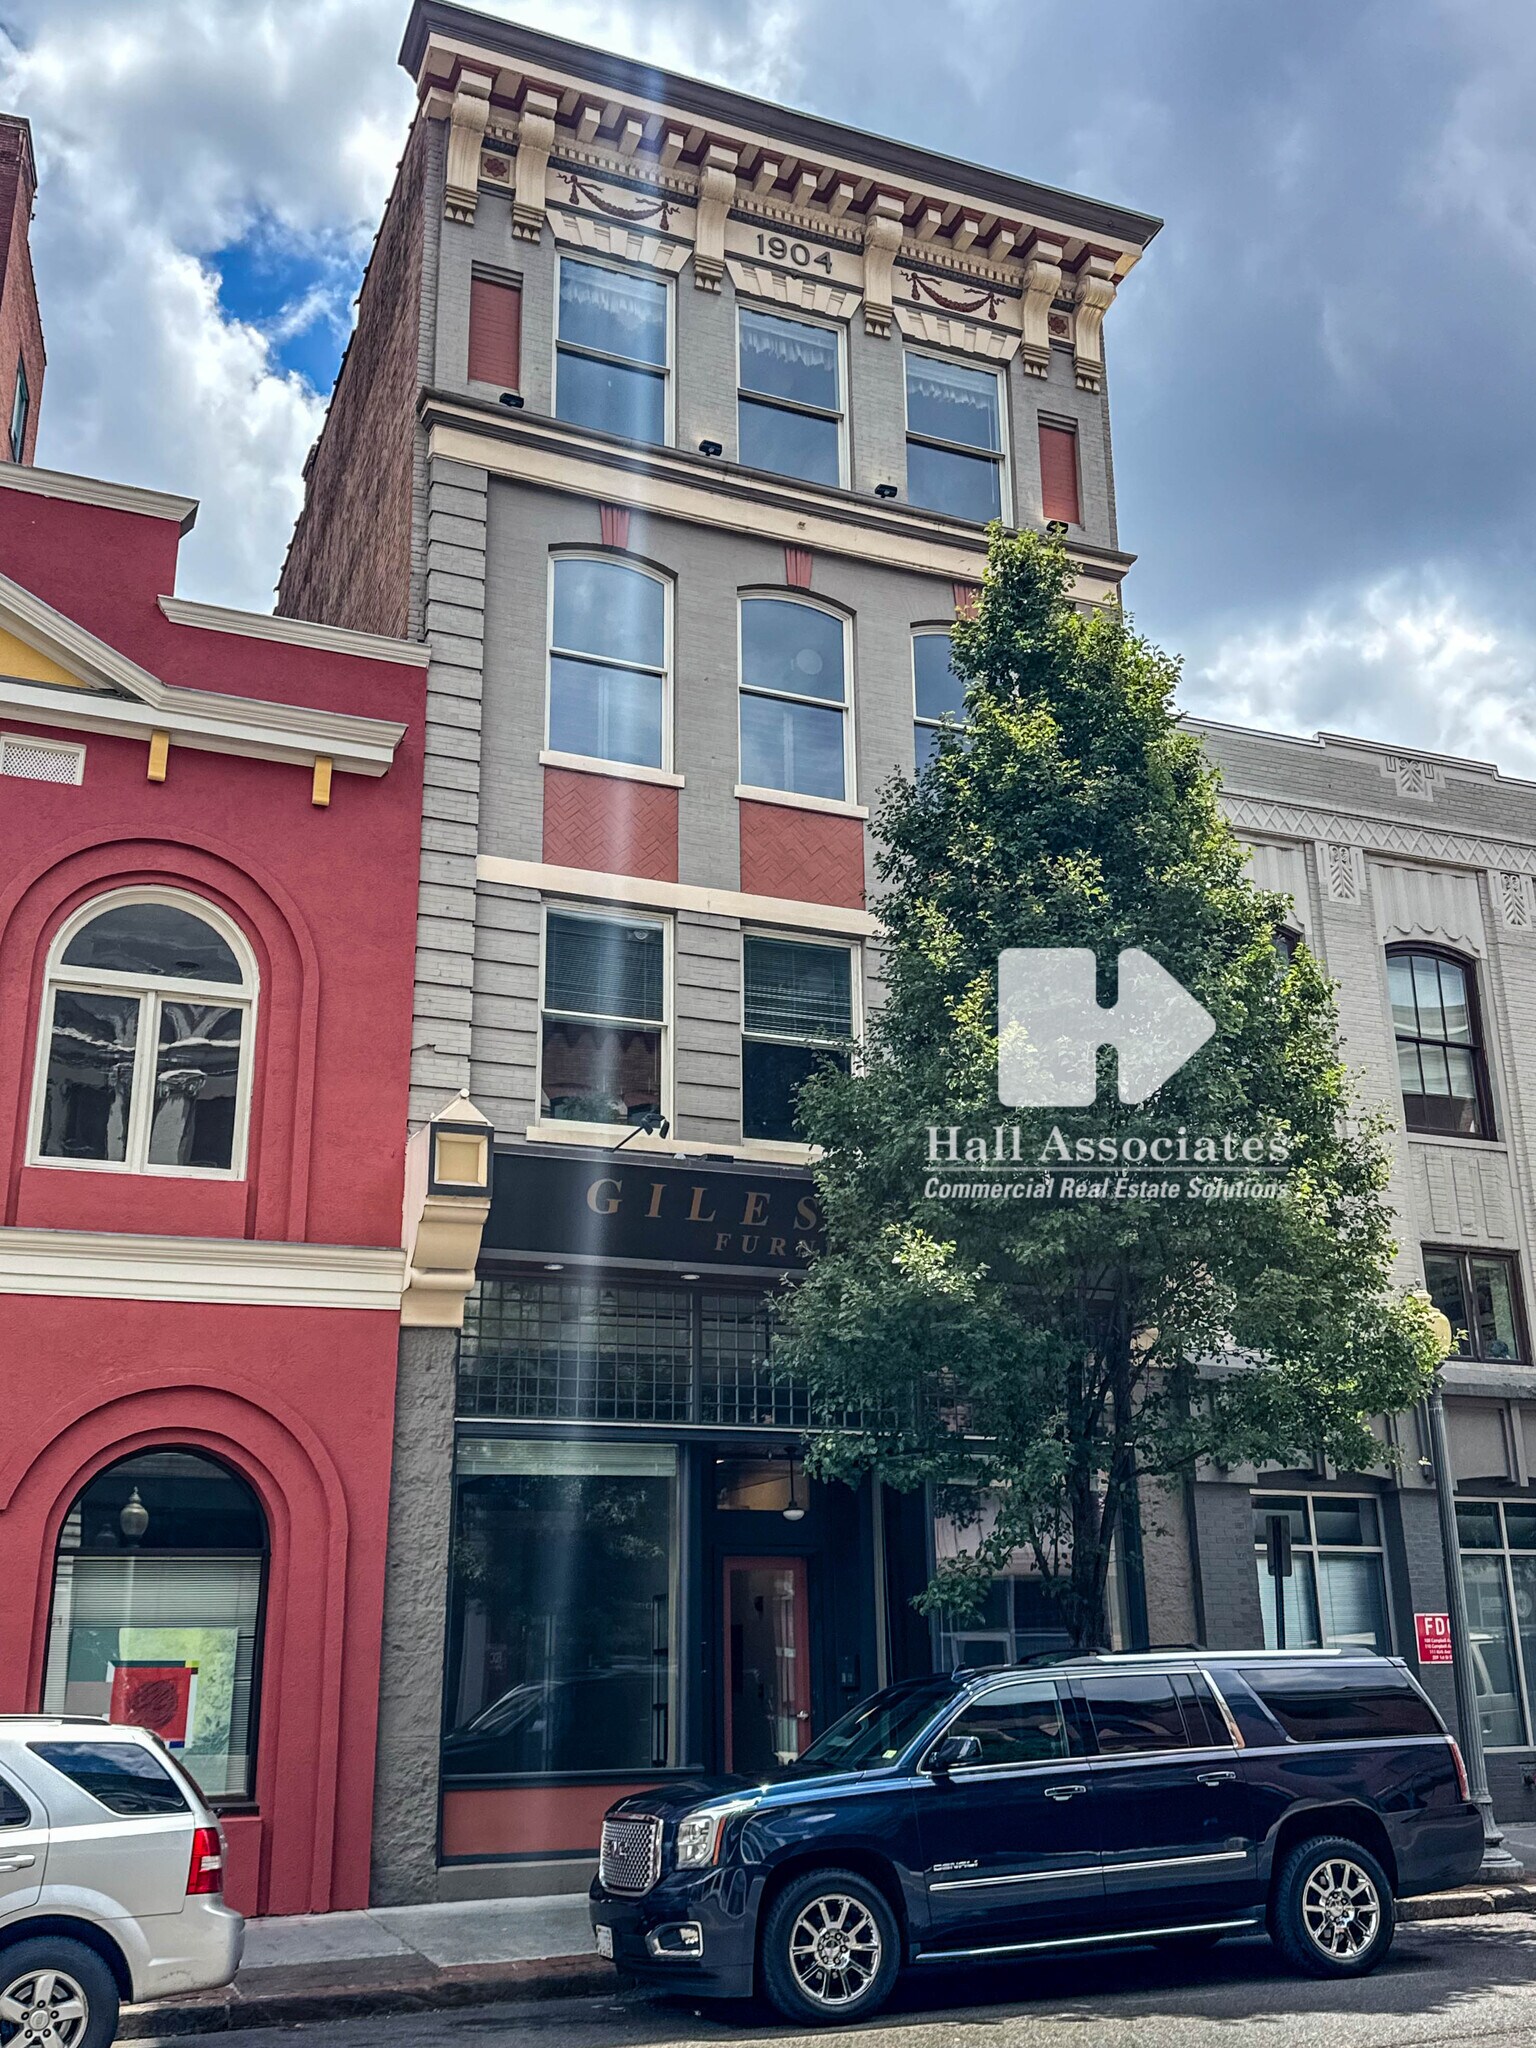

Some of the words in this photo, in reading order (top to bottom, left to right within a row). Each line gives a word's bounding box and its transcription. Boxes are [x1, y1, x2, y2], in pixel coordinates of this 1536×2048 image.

[757, 233, 833, 274] 1904
[586, 1178, 818, 1231] GILES
[1424, 1617, 1450, 1636] FD
